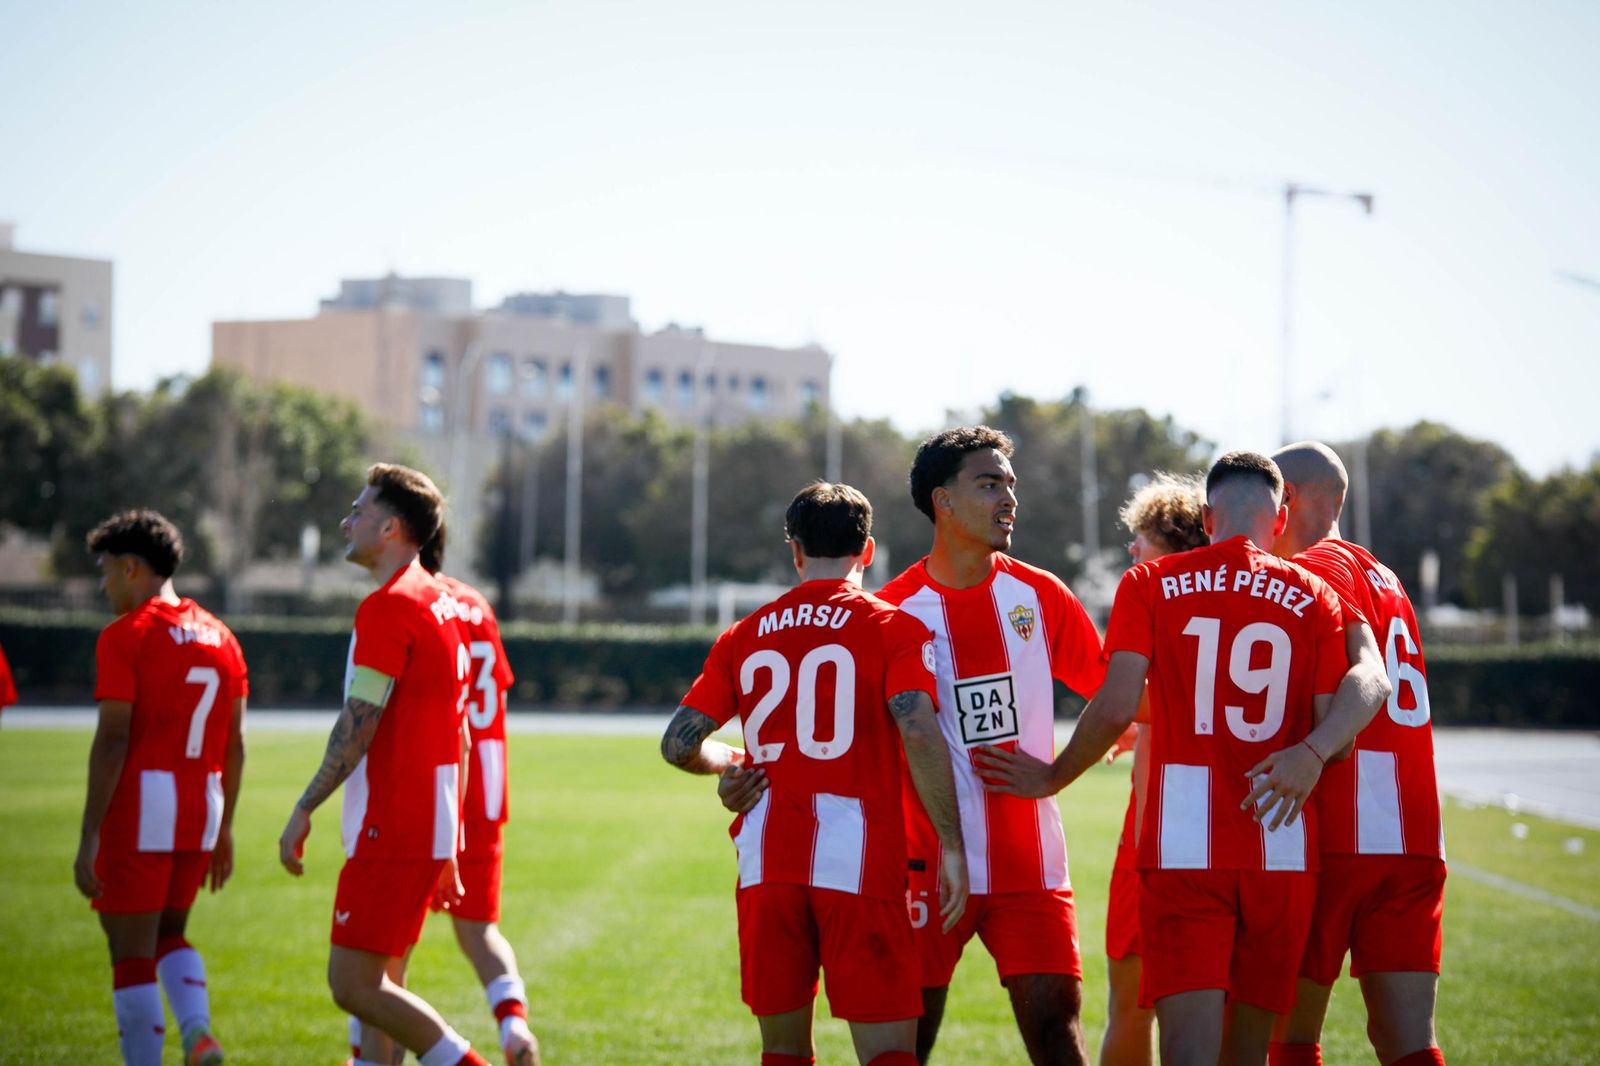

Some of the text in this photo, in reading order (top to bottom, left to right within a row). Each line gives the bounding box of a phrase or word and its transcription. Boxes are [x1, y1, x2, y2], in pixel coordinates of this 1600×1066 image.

[757, 603, 852, 638] MARSU
[1161, 564, 1314, 618] RENÉ PÉREZ
[185, 666, 220, 759] 7
[740, 643, 856, 764] 20
[1182, 616, 1292, 742] 19
[1385, 616, 1431, 727] 6
